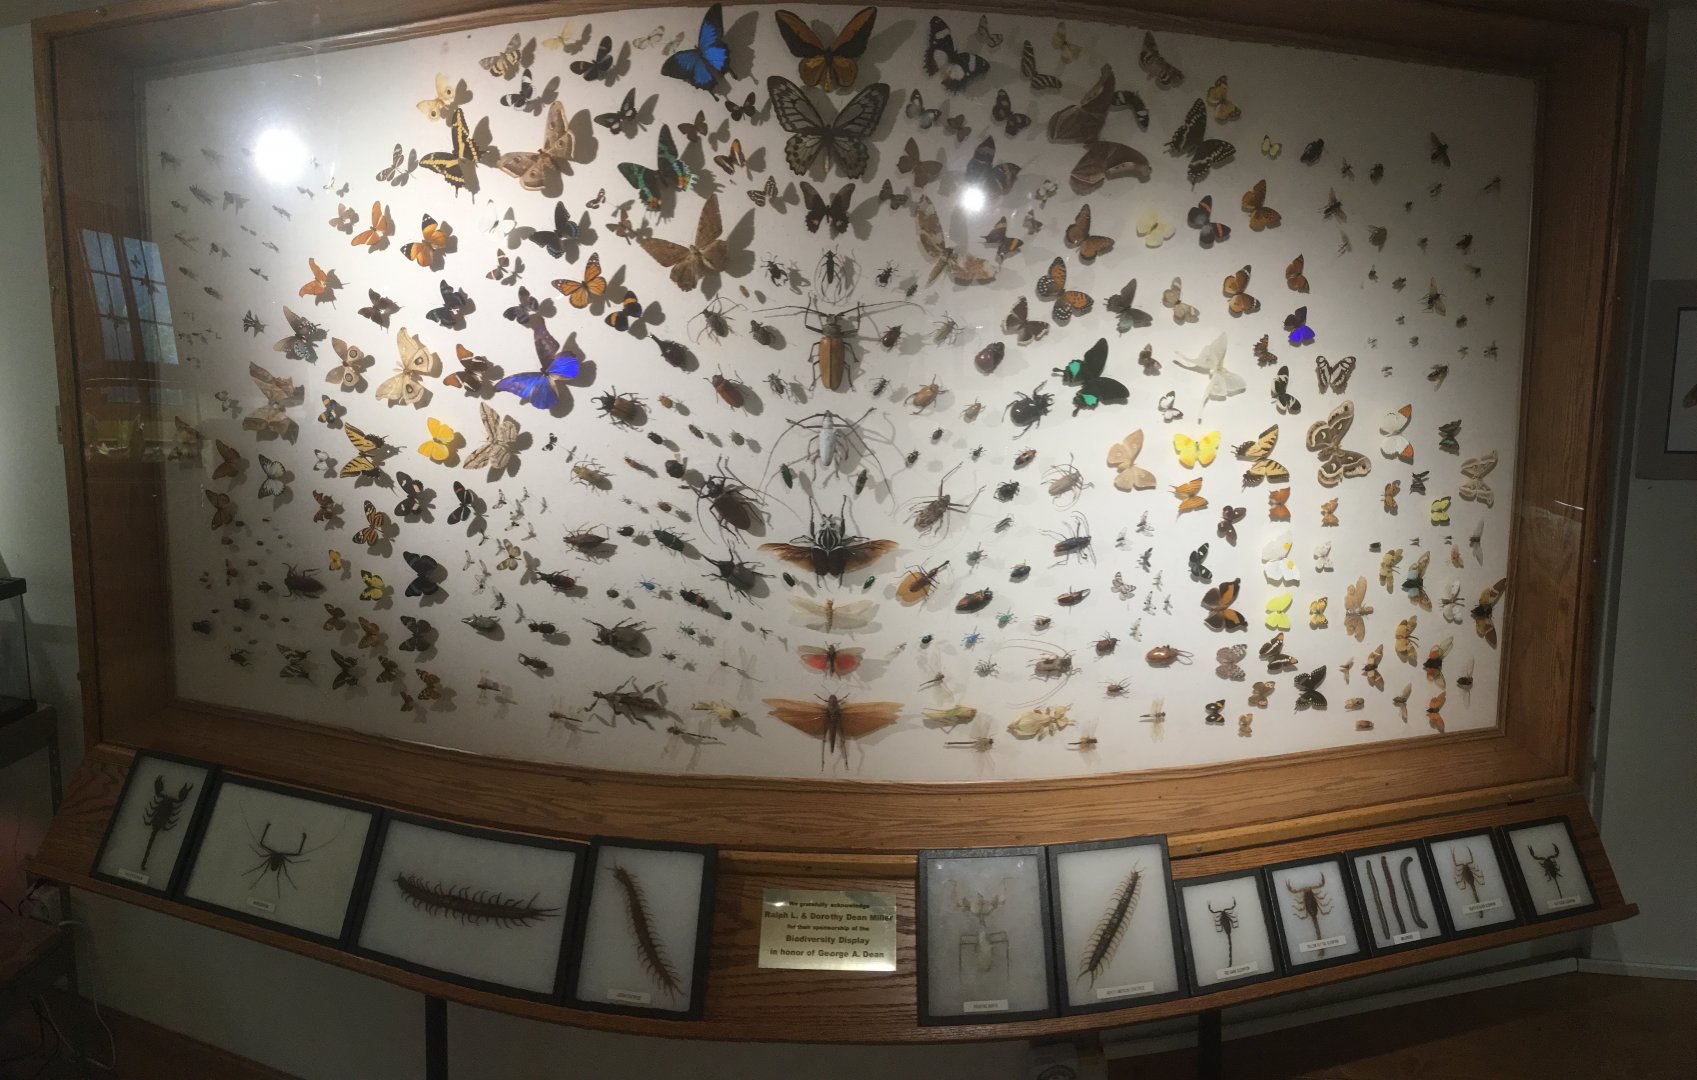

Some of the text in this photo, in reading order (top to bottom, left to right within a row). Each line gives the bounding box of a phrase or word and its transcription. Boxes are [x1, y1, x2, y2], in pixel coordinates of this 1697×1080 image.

[765, 911, 788, 919] Ralph
[810, 913, 843, 921] Dorothy
[786, 935, 870, 945] Biodiversity Display
[818, 950, 849, 958] George
